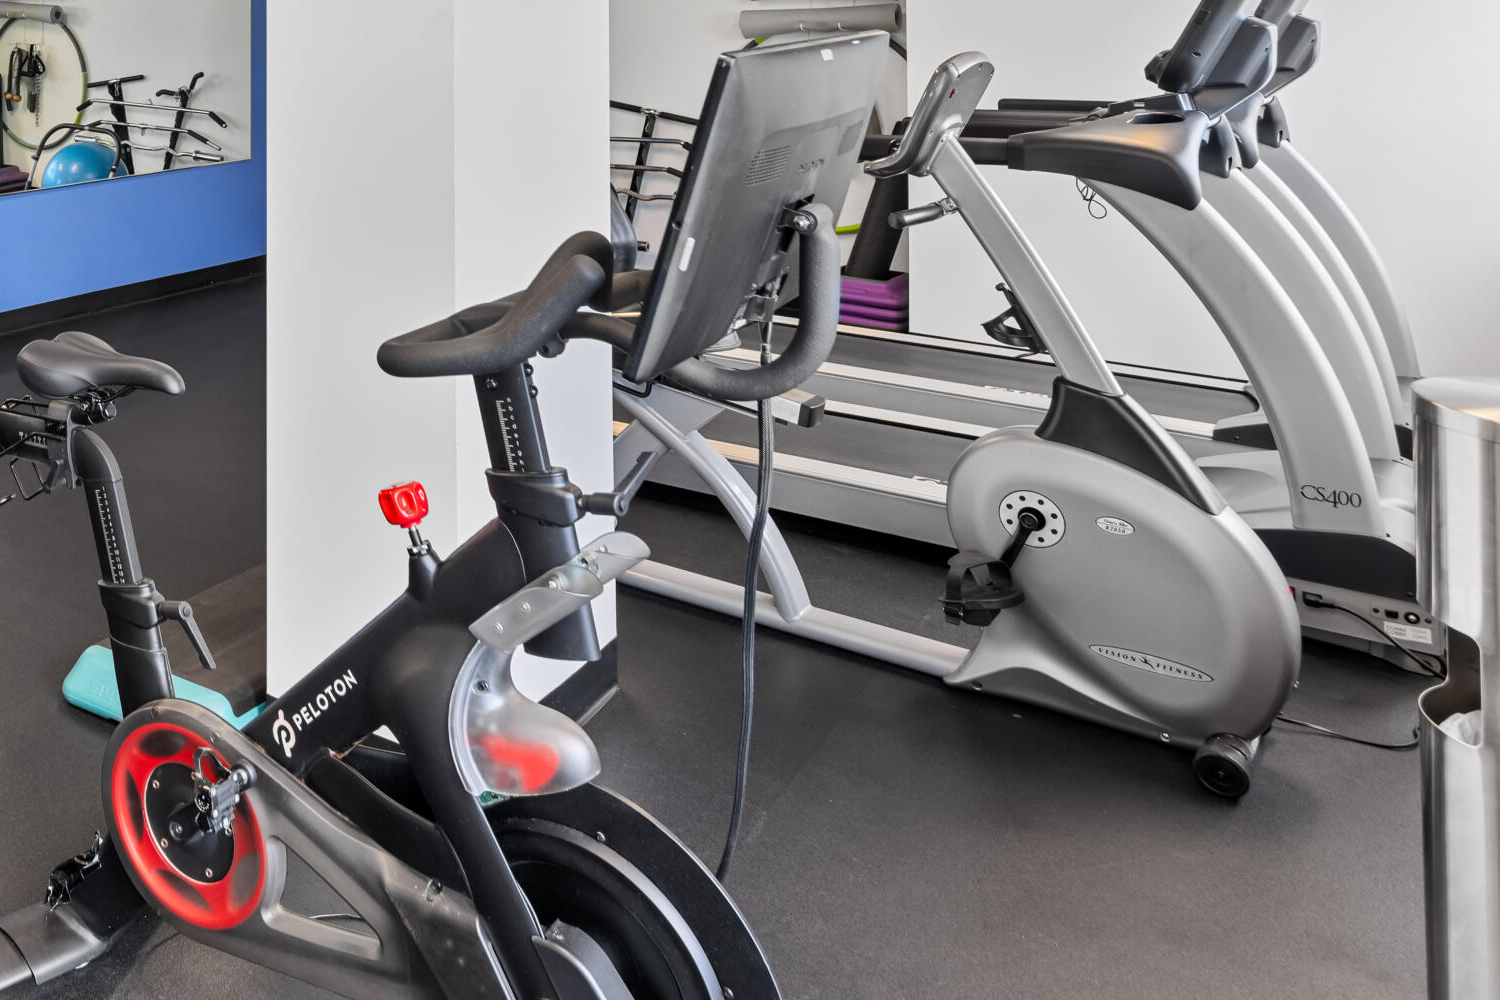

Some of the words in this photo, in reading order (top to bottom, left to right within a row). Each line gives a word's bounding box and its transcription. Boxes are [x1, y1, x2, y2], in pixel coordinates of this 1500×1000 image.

[1299, 484, 1362, 508] CS400
[1098, 647, 1137, 662] VISION
[1156, 663, 1204, 680] FITNESS
[292, 668, 359, 732] PELOTON
